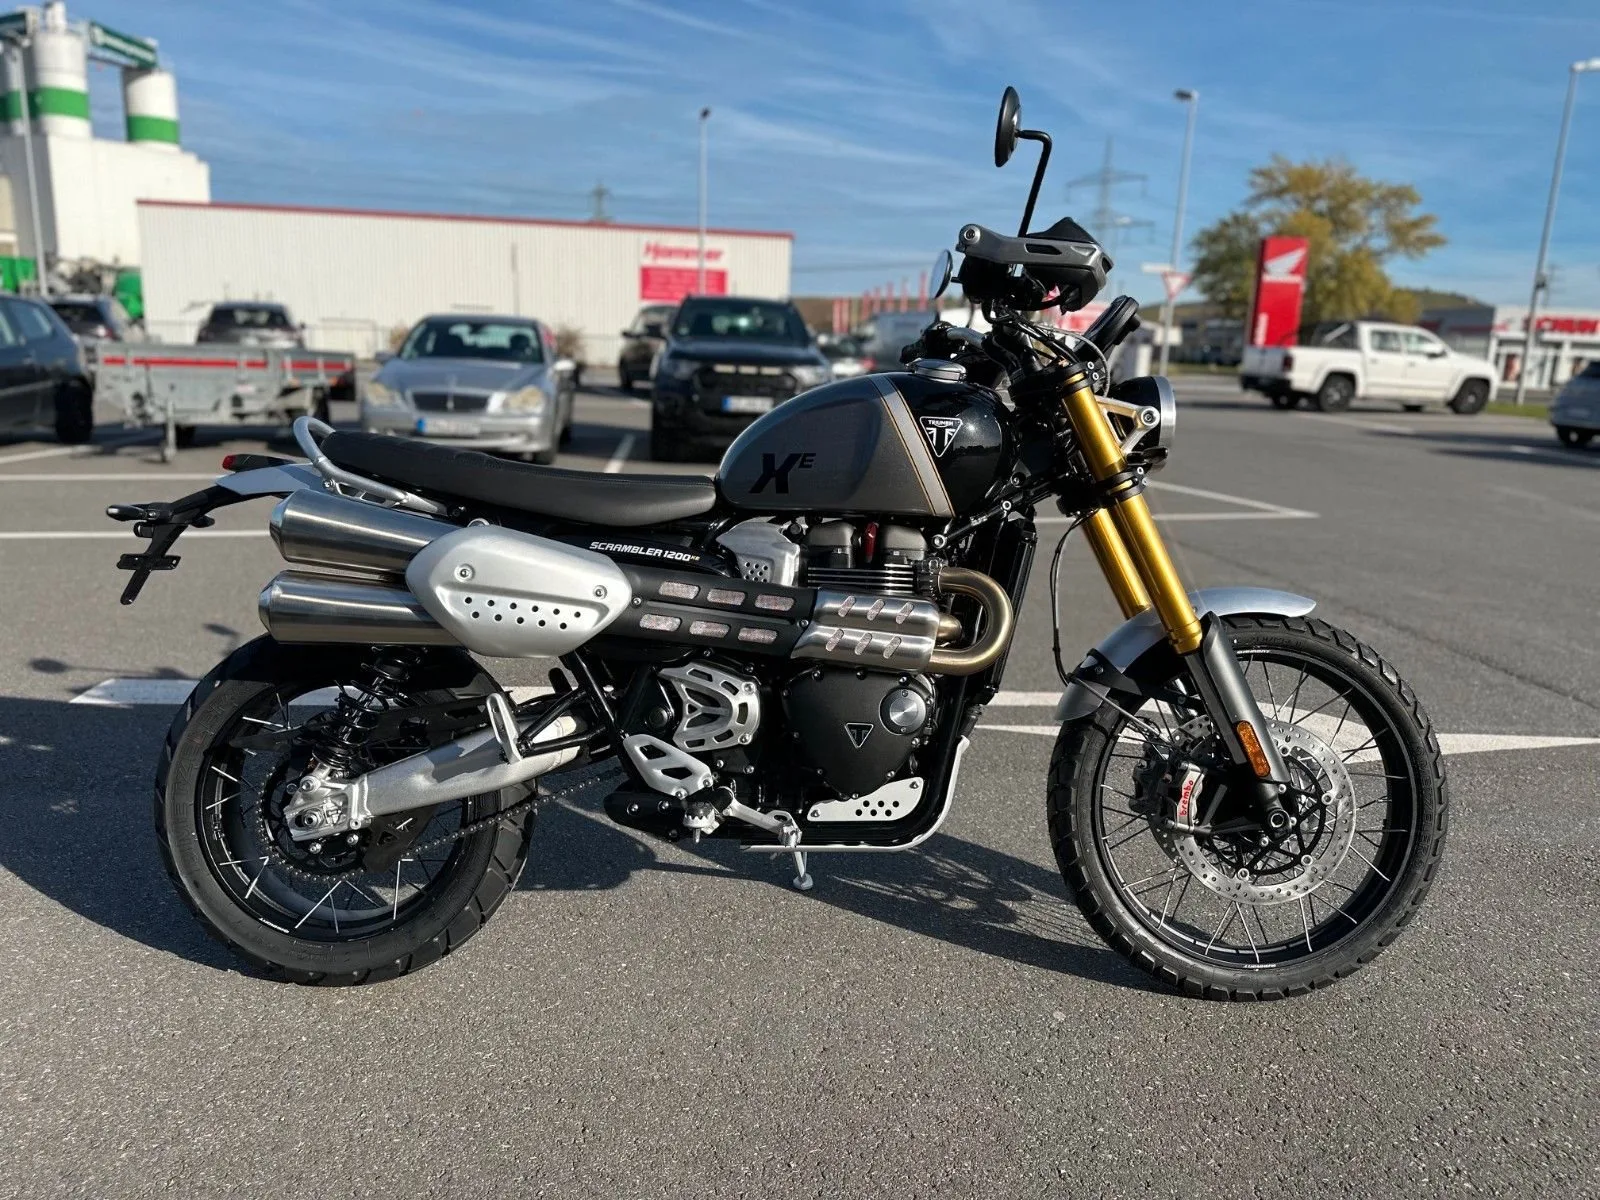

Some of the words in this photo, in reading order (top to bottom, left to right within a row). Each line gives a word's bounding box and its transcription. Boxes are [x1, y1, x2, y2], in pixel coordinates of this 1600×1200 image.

[749, 453, 816, 494] XE
[589, 541, 663, 557] SCRAMBLER
[1179, 780, 1194, 816] brembo
